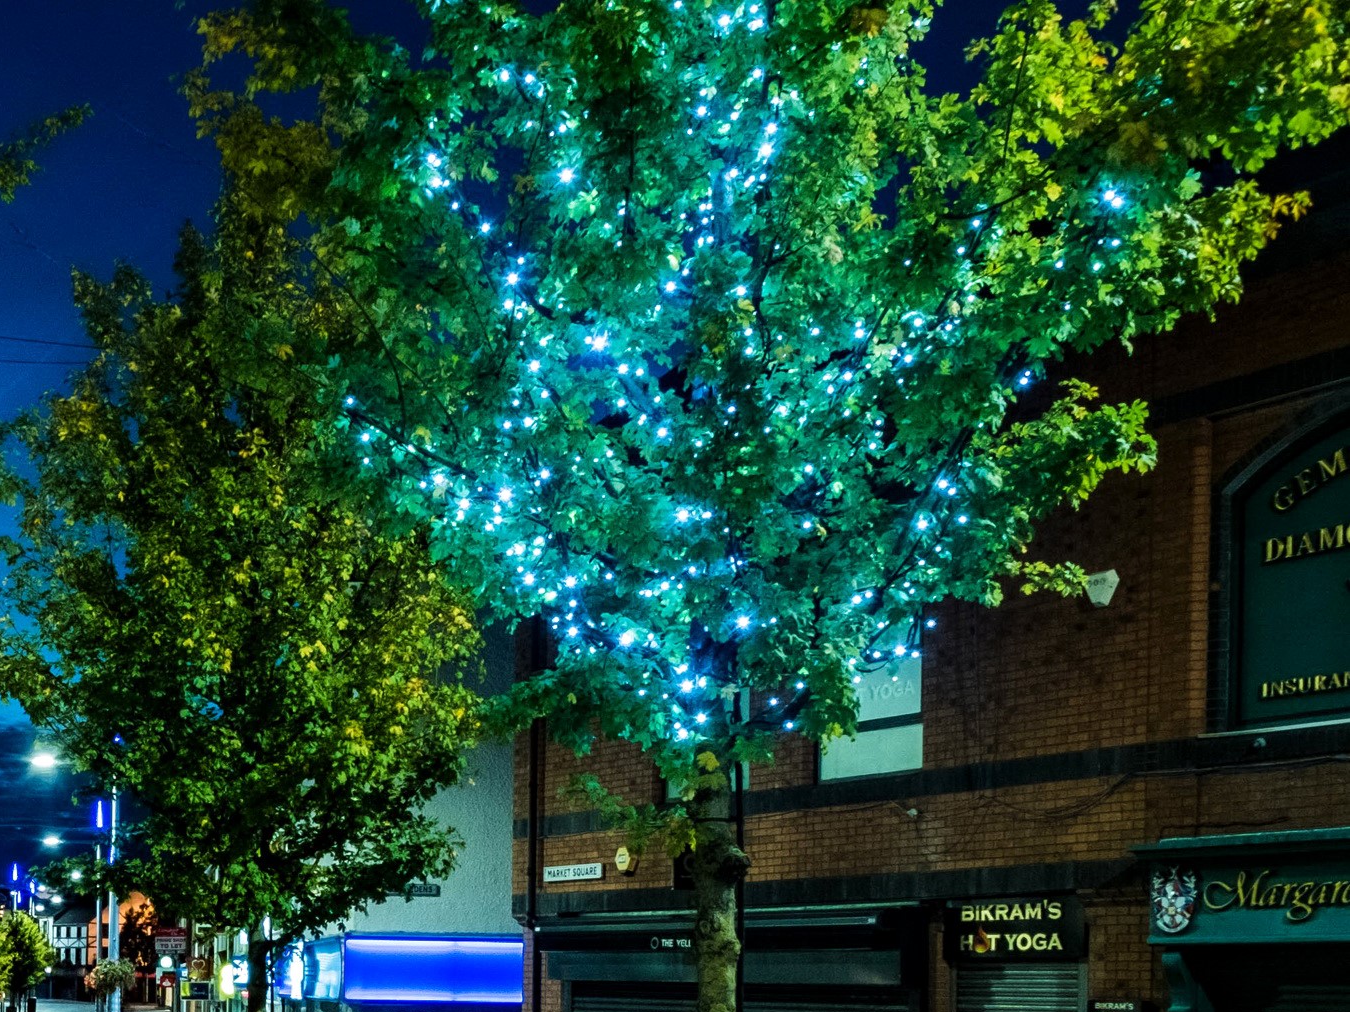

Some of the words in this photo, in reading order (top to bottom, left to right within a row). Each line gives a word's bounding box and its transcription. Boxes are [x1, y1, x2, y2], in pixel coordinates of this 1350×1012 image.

[547, 869, 570, 878] MARKET
[572, 866, 597, 877] SQUARE
[961, 899, 1062, 922] BIKRAM'S
[661, 938, 674, 947] THE
[1005, 932, 1063, 951] YOGA
[1095, 1002, 1134, 1011] BIKRAM'S
